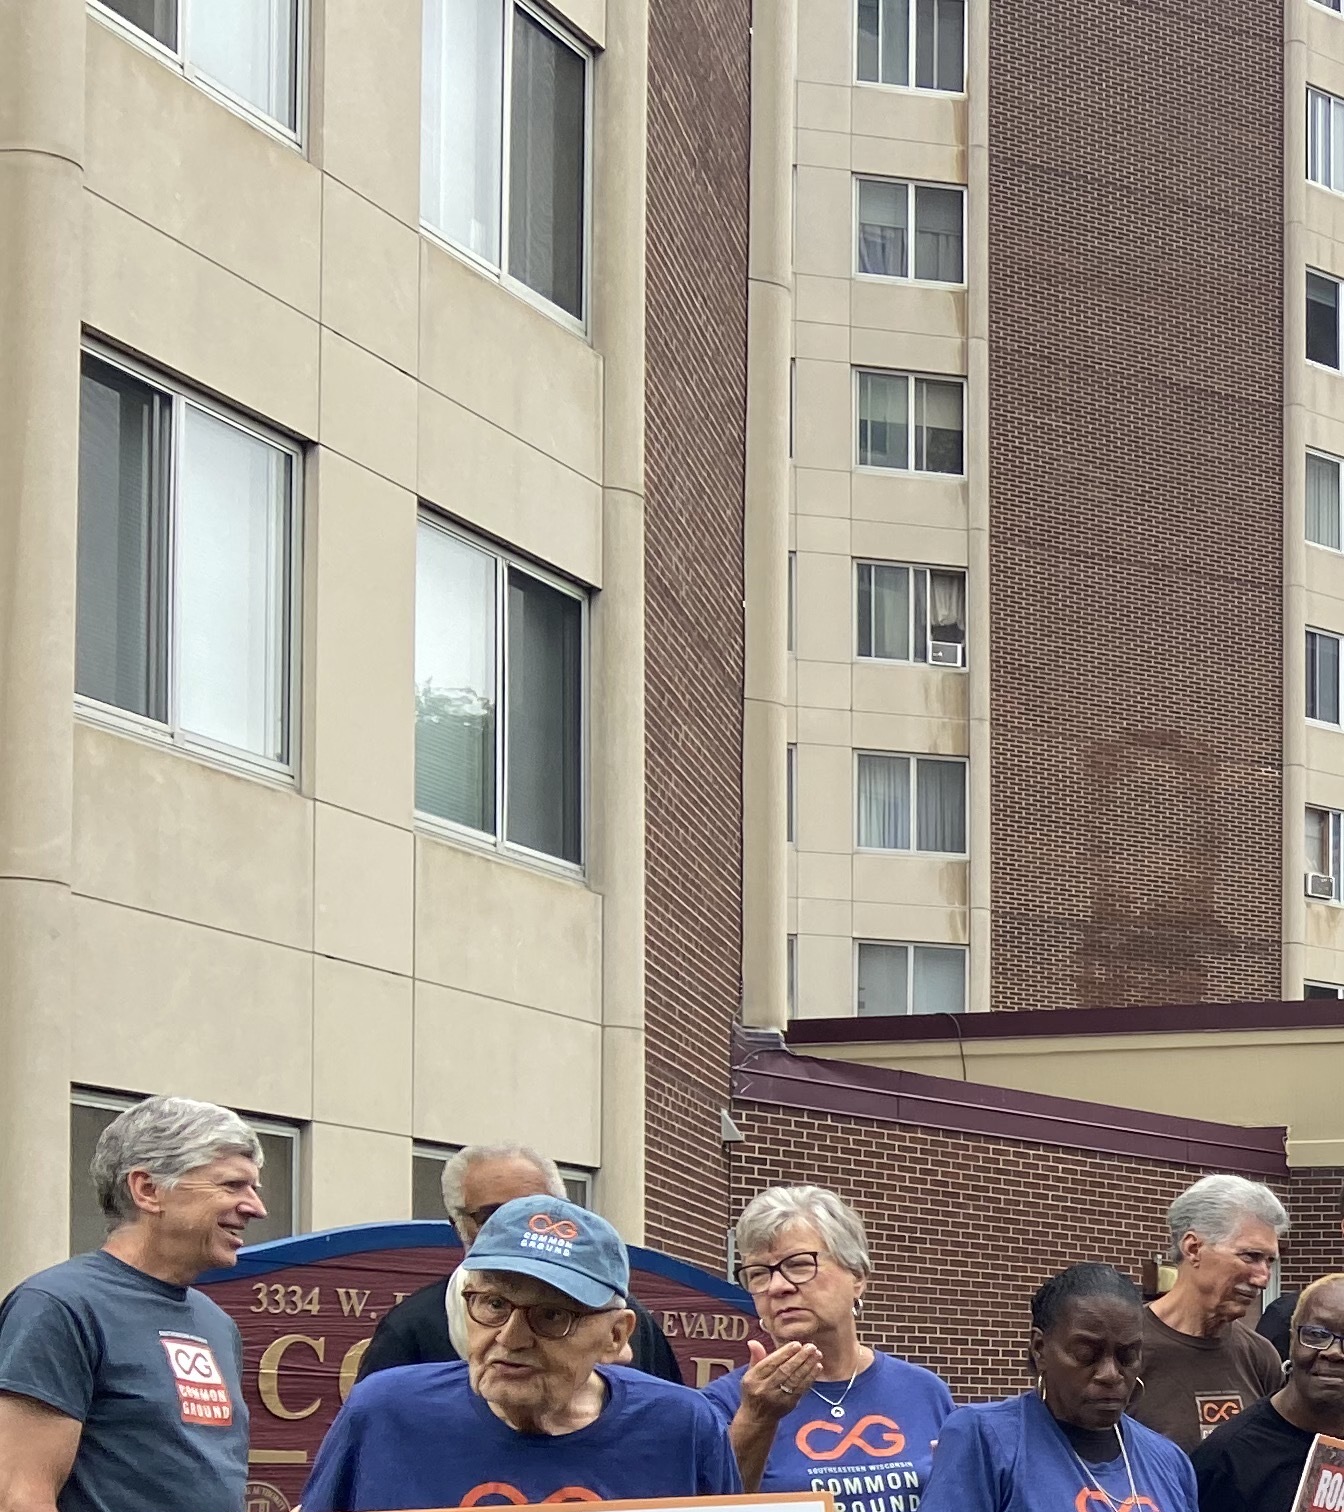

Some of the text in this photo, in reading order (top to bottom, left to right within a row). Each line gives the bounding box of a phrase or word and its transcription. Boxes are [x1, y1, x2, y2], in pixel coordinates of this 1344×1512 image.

[250, 1283, 321, 1315] 3334
[336, 1288, 377, 1319] W.
[658, 1310, 749, 1341] EVARD
